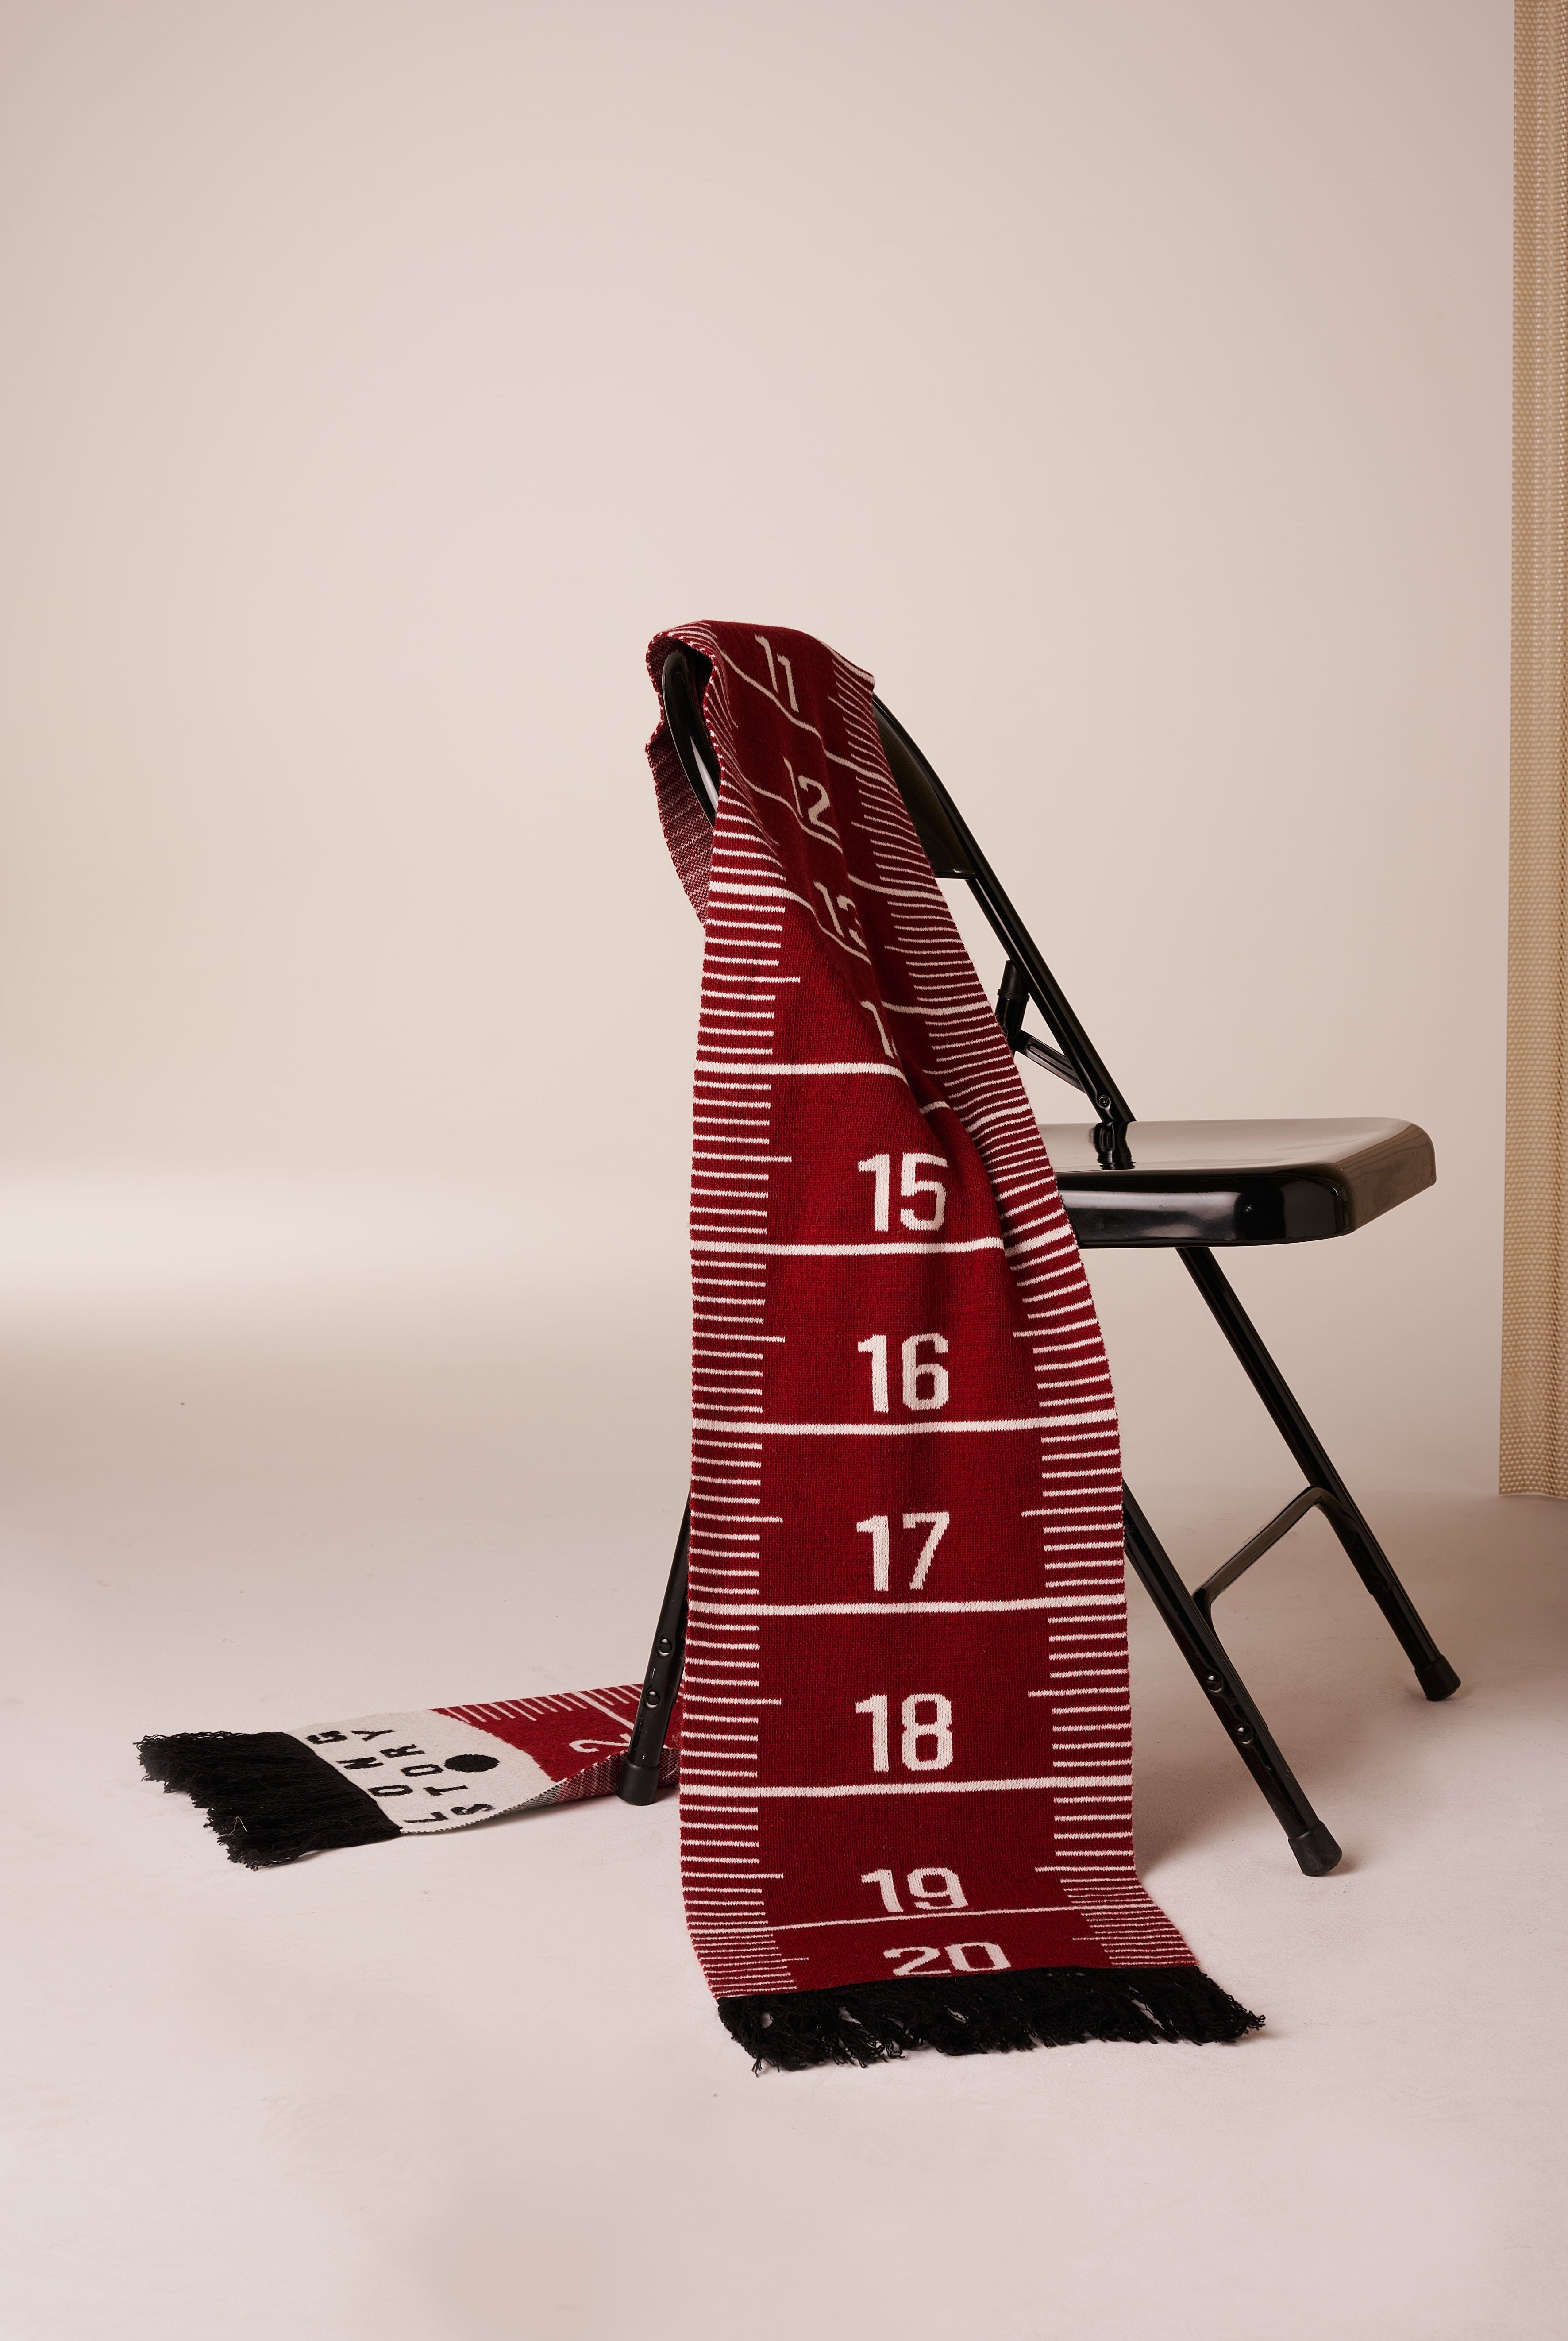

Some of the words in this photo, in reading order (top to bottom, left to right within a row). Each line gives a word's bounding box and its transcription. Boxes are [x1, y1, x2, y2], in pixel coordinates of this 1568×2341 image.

[754, 633, 799, 713] 11
[783, 756, 839, 839] 12
[860, 1000, 901, 1059] 1
[858, 1152, 948, 1232] 15
[857, 1333, 949, 1413] 16
[856, 1511, 950, 1591] 17
[855, 1693, 953, 1772] 18
[861, 1867, 968, 1913] 19
[883, 1942, 1011, 1976] 20
